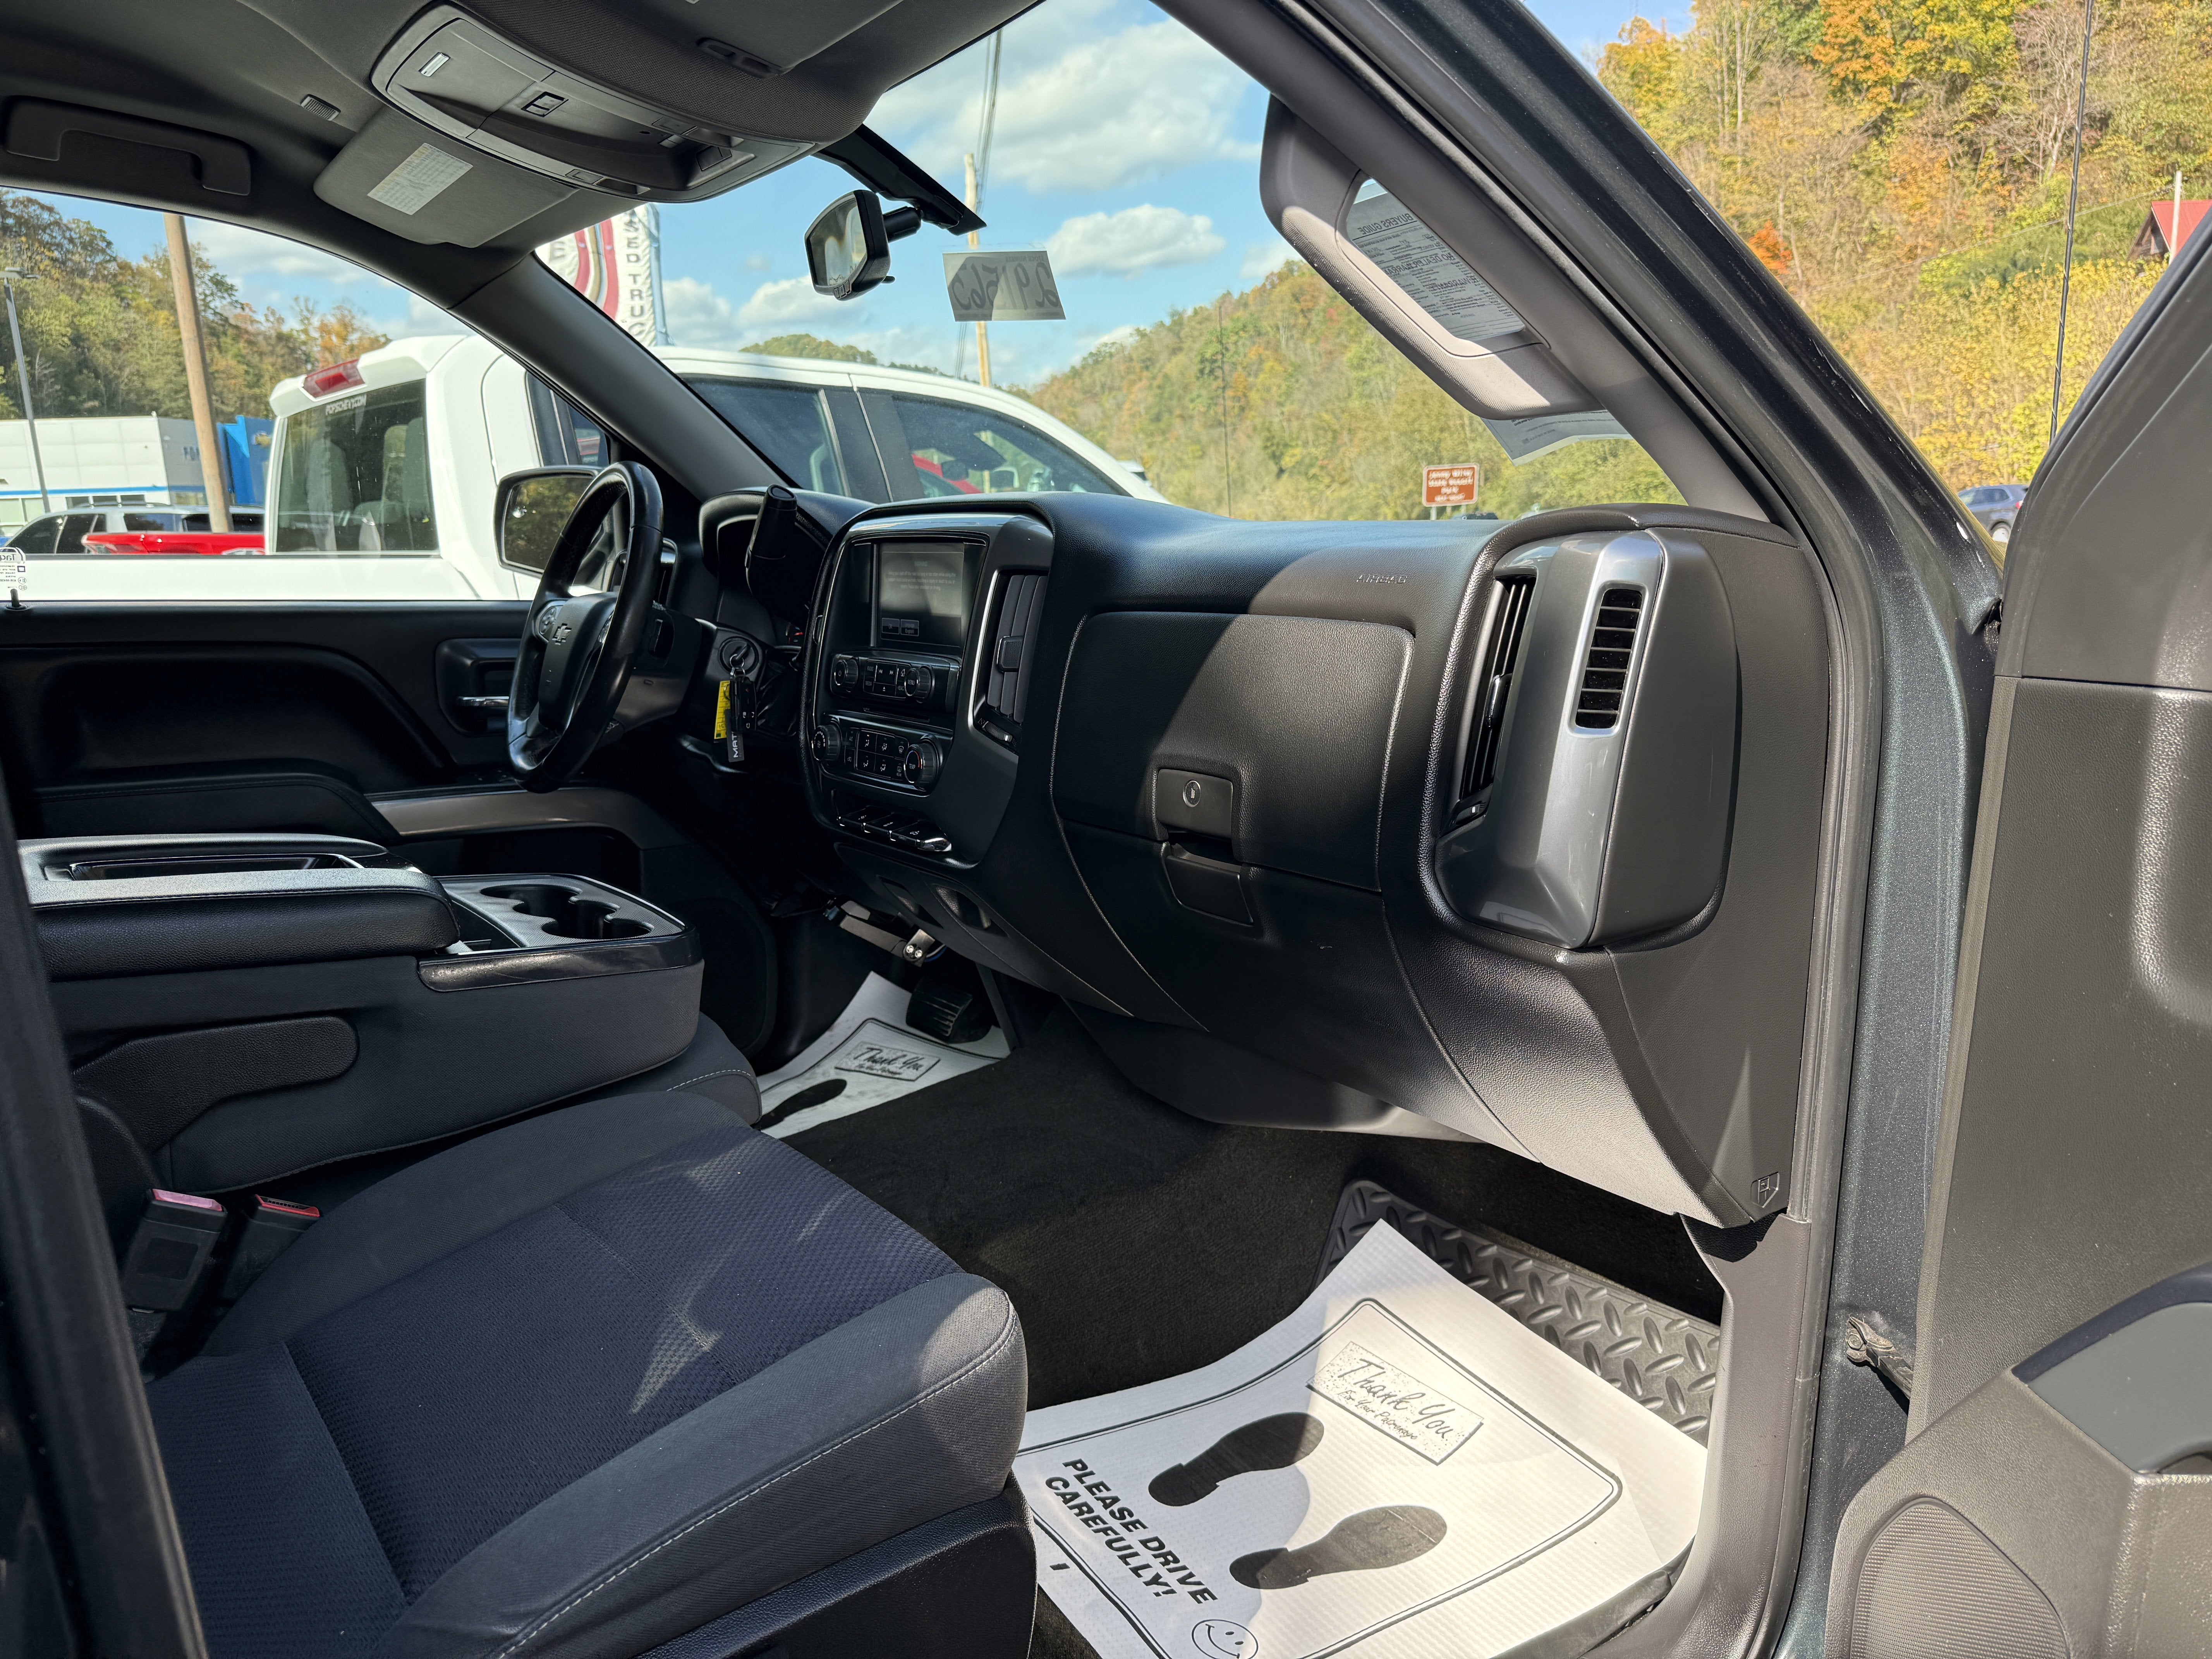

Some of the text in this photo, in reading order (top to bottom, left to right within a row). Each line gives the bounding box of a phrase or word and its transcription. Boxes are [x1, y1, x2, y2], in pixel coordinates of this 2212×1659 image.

[1357, 574, 1407, 584] AIRBAG
[1337, 1389, 1355, 1401] For
[1355, 1400, 1375, 1413] Your
[1338, 1358, 1455, 1439] Thank You
[1045, 1476, 1177, 1597] CAREFULLY!
[1062, 1458, 1218, 1604] PLEASE DRIVE
